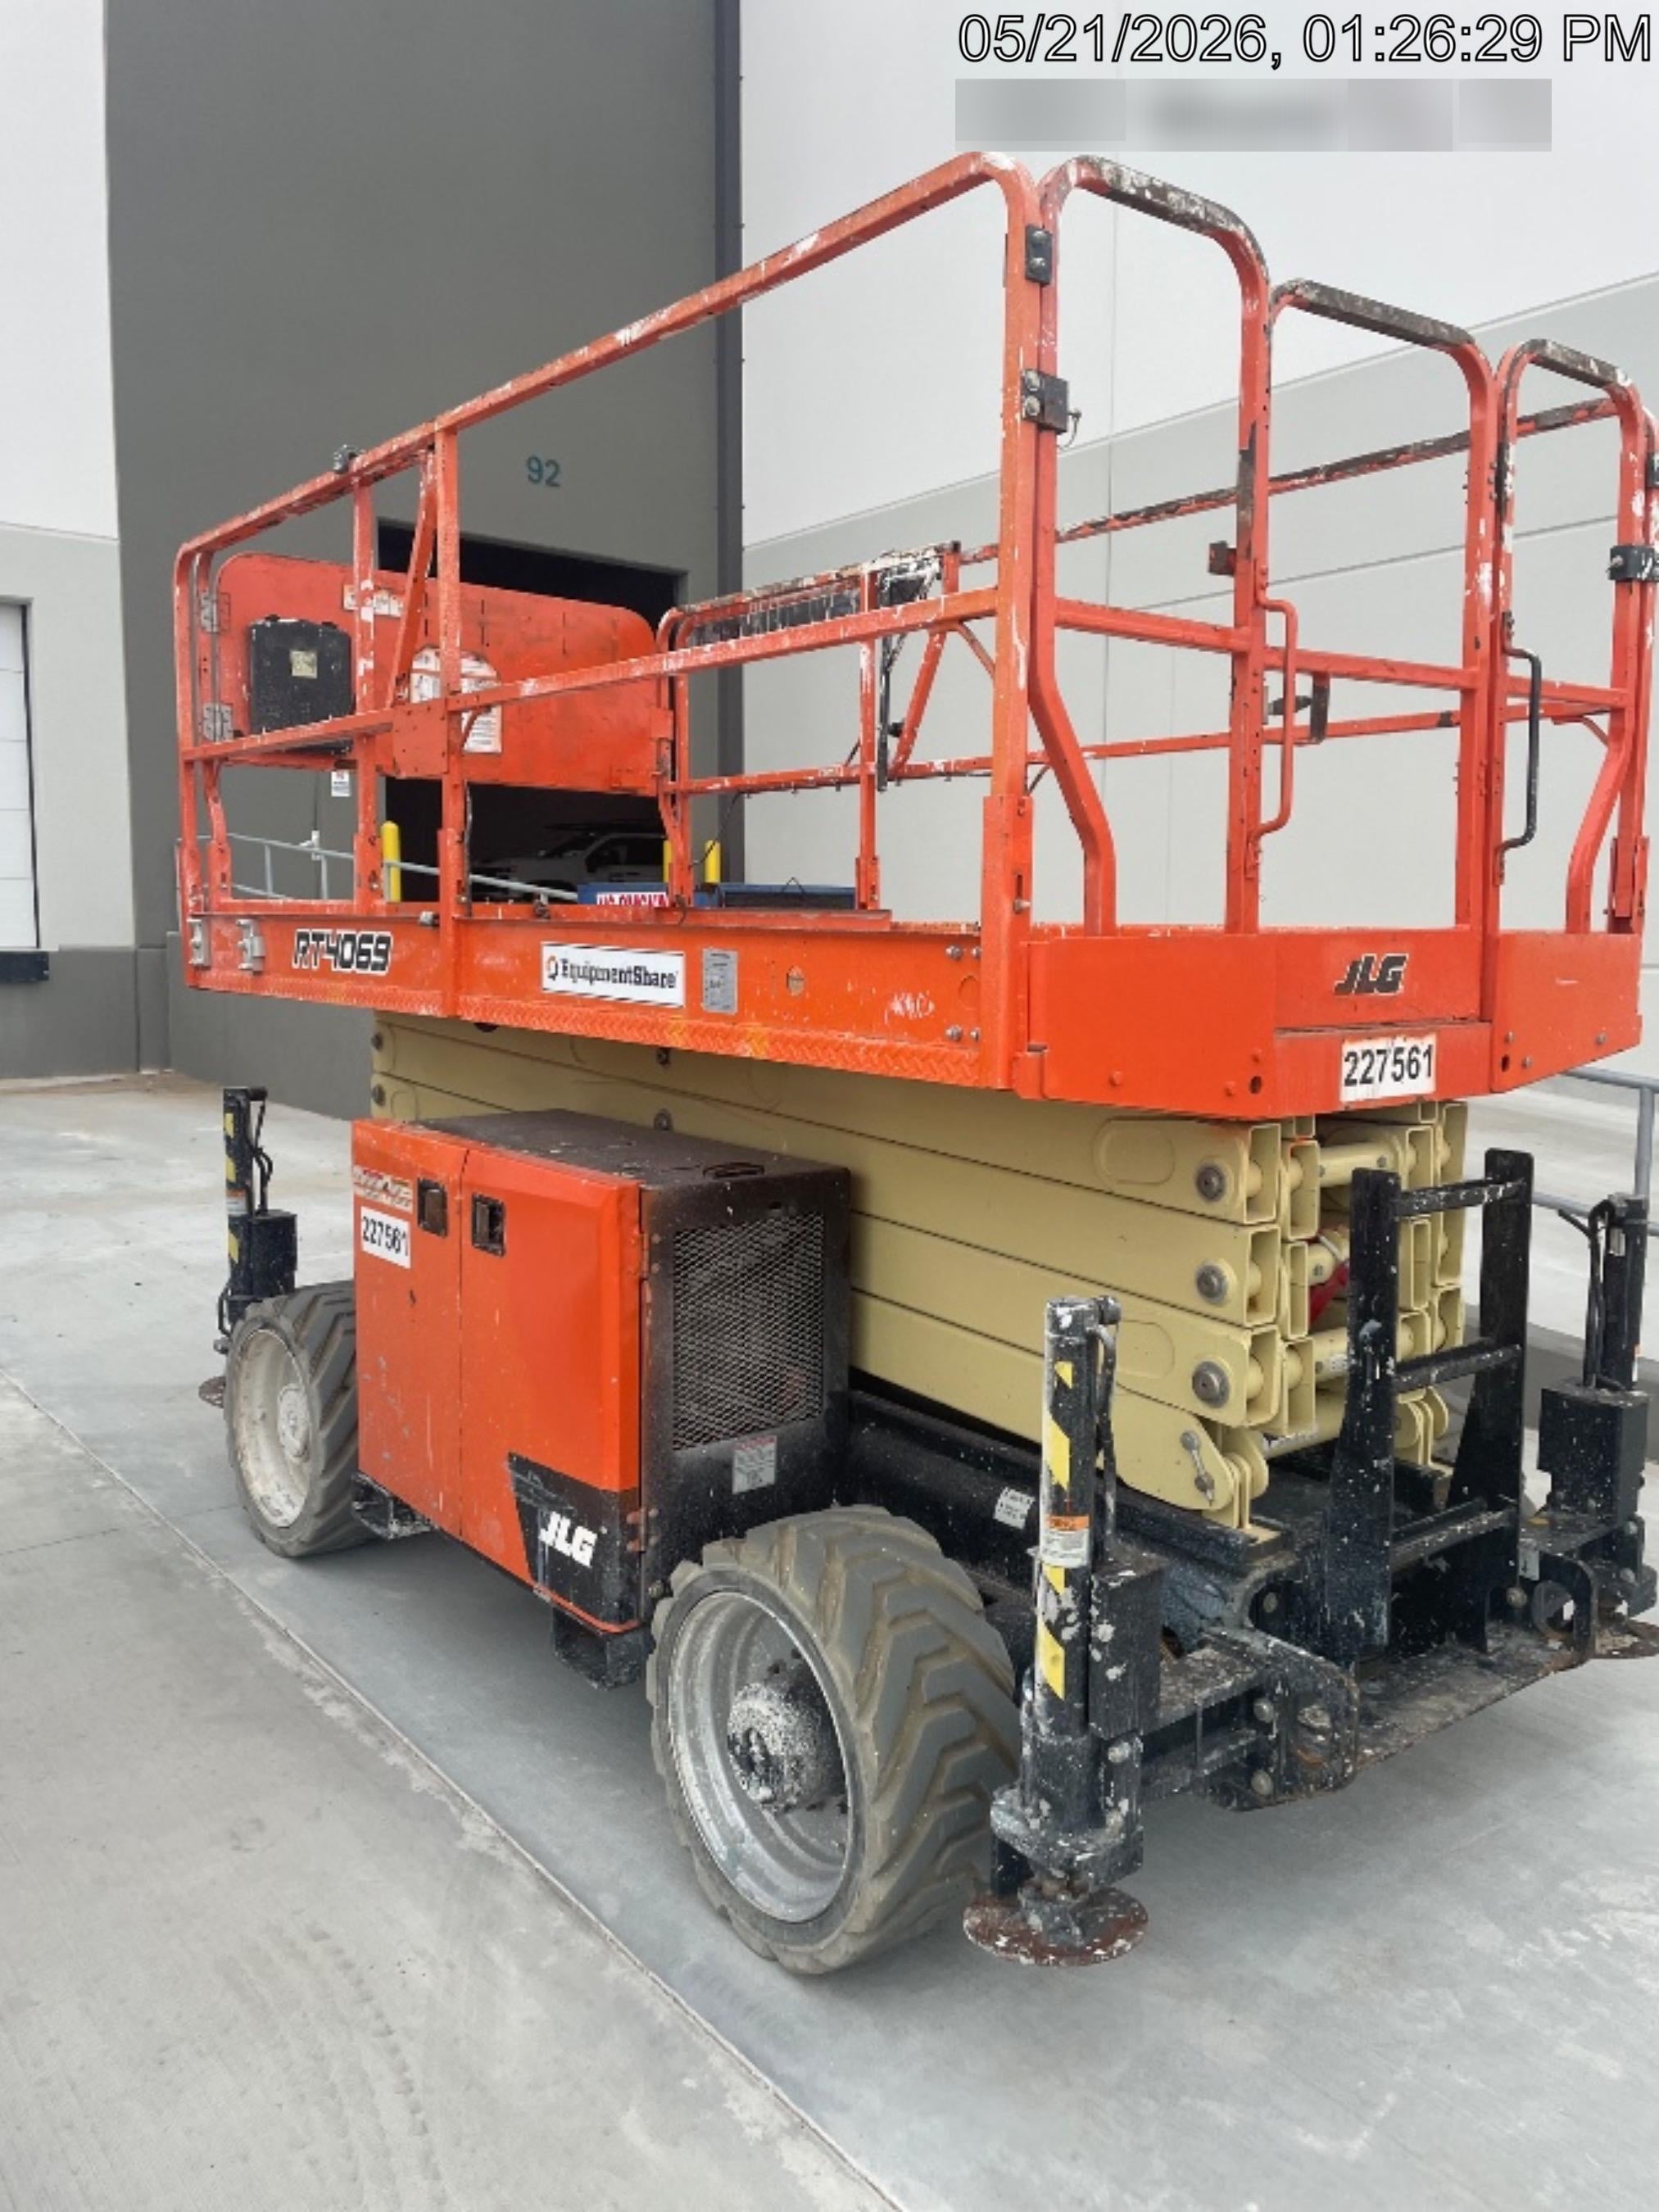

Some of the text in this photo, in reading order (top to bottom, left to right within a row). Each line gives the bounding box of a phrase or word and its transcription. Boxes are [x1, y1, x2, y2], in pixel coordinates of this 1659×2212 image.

[527, 455, 560, 487] 92
[293, 929, 392, 974] RT4069
[561, 959, 677, 989] EquipmentShare
[1334, 954, 1408, 995] JLG
[1344, 1045, 1433, 1087] 227561
[363, 1216, 409, 1257] 227561
[538, 1511, 598, 1569] JLG
